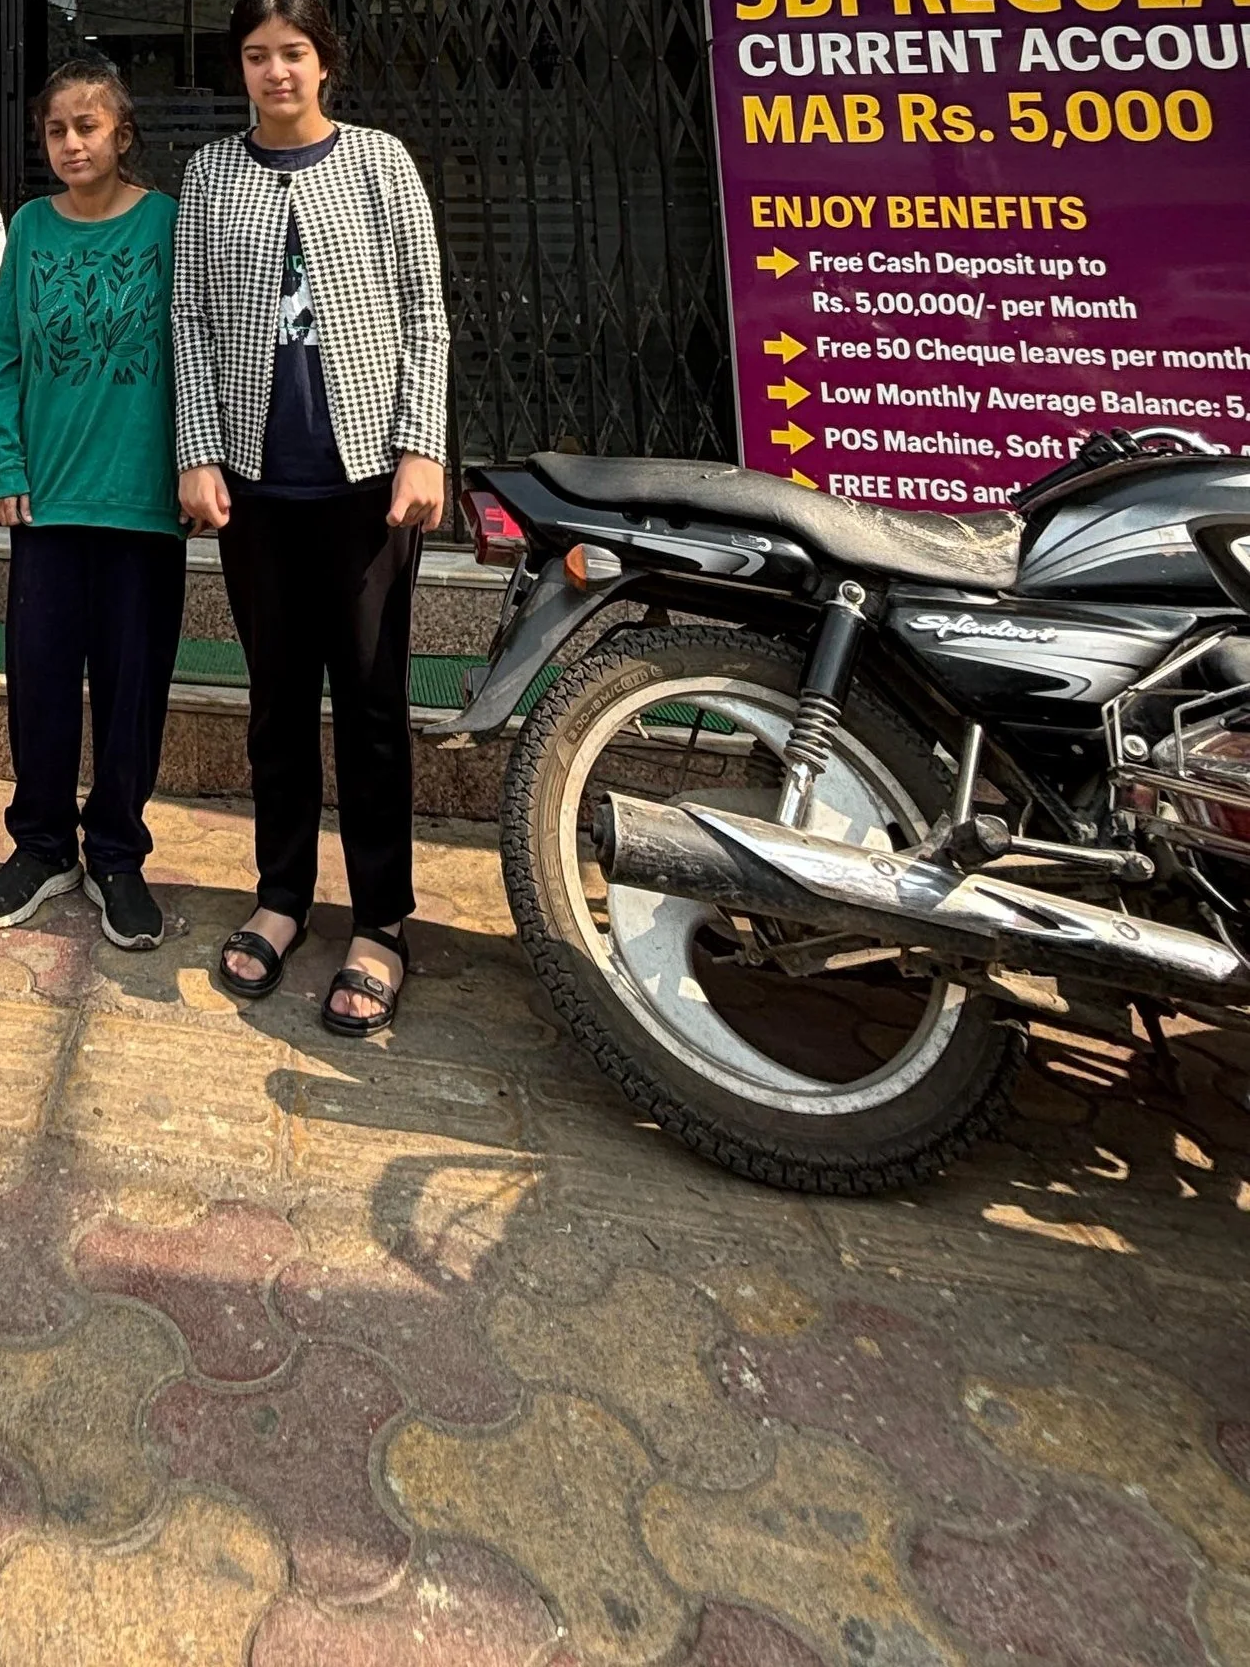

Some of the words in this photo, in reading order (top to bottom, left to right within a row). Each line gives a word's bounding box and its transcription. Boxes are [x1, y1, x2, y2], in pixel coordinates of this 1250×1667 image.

[737, 29, 1002, 78] CURRENT
[1019, 24, 1250, 73] ACCOU
[742, 93, 886, 144] MAB
[900, 93, 995, 144] Rs.
[1009, 89, 1214, 150] 5,000
[751, 195, 879, 229] ENJOY
[887, 196, 1088, 230] BENEFITS
[809, 251, 863, 273] Free
[868, 251, 931, 274] Cash
[935, 252, 1034, 279] Deposit
[1040, 257, 1073, 280] up
[1077, 255, 1107, 278] to
[812, 292, 851, 314] Rs.
[855, 291, 997, 319] 5,00,000/-
[1001, 298, 1045, 321] per
[1050, 296, 1138, 320] Month
[817, 336, 872, 359] Free
[876, 337, 911, 360] 50
[915, 338, 1016, 366] Cheque
[1019, 340, 1106, 367] leaves
[1111, 347, 1158, 372] per
[1162, 346, 1250, 371] month
[820, 382, 871, 405] Low
[877, 383, 980, 413] Monthly
[987, 387, 1097, 416] Average
[1101, 390, 1222, 418] Balance:
[824, 427, 879, 450] POS
[883, 430, 1002, 459] Machine,
[1007, 435, 1063, 460] Soft
[828, 473, 893, 499] FREE
[897, 477, 968, 503] RTGS
[972, 482, 1021, 504] and
